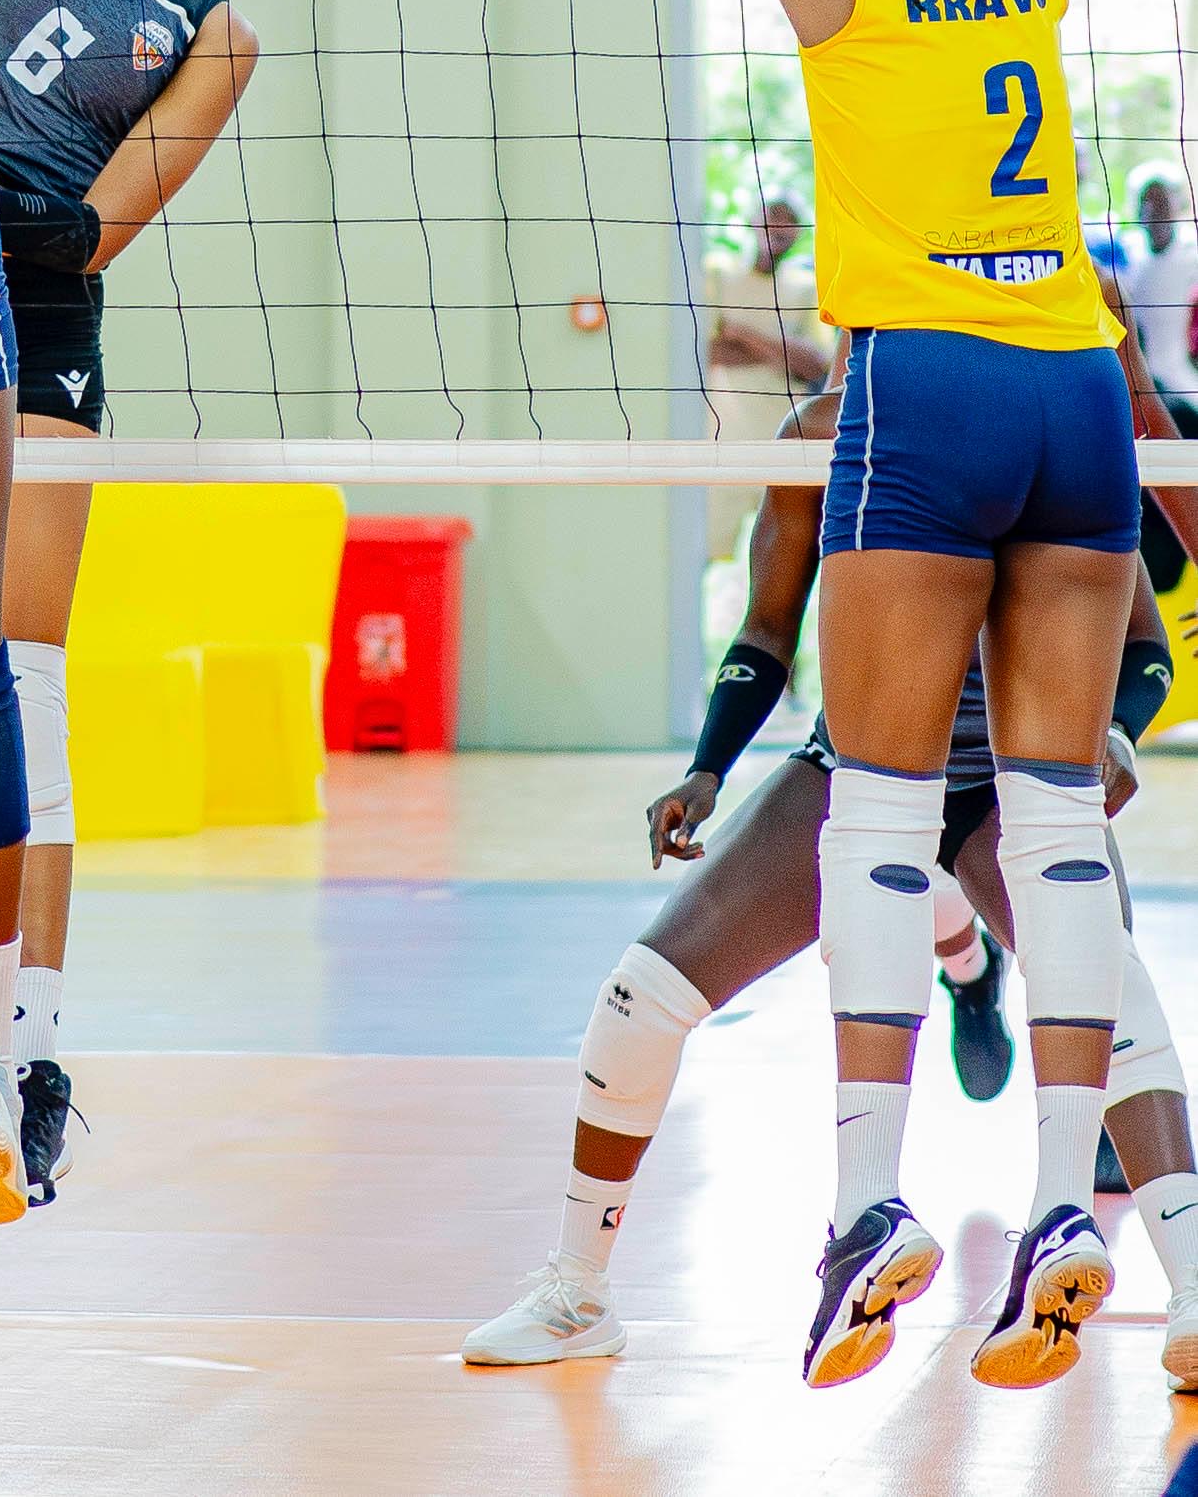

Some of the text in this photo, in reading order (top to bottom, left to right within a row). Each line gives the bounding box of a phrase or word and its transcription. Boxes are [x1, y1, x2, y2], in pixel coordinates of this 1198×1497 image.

[6, 7, 96, 96] 6
[984, 60, 1049, 198] 2
[995, 255, 1058, 285] EBM
